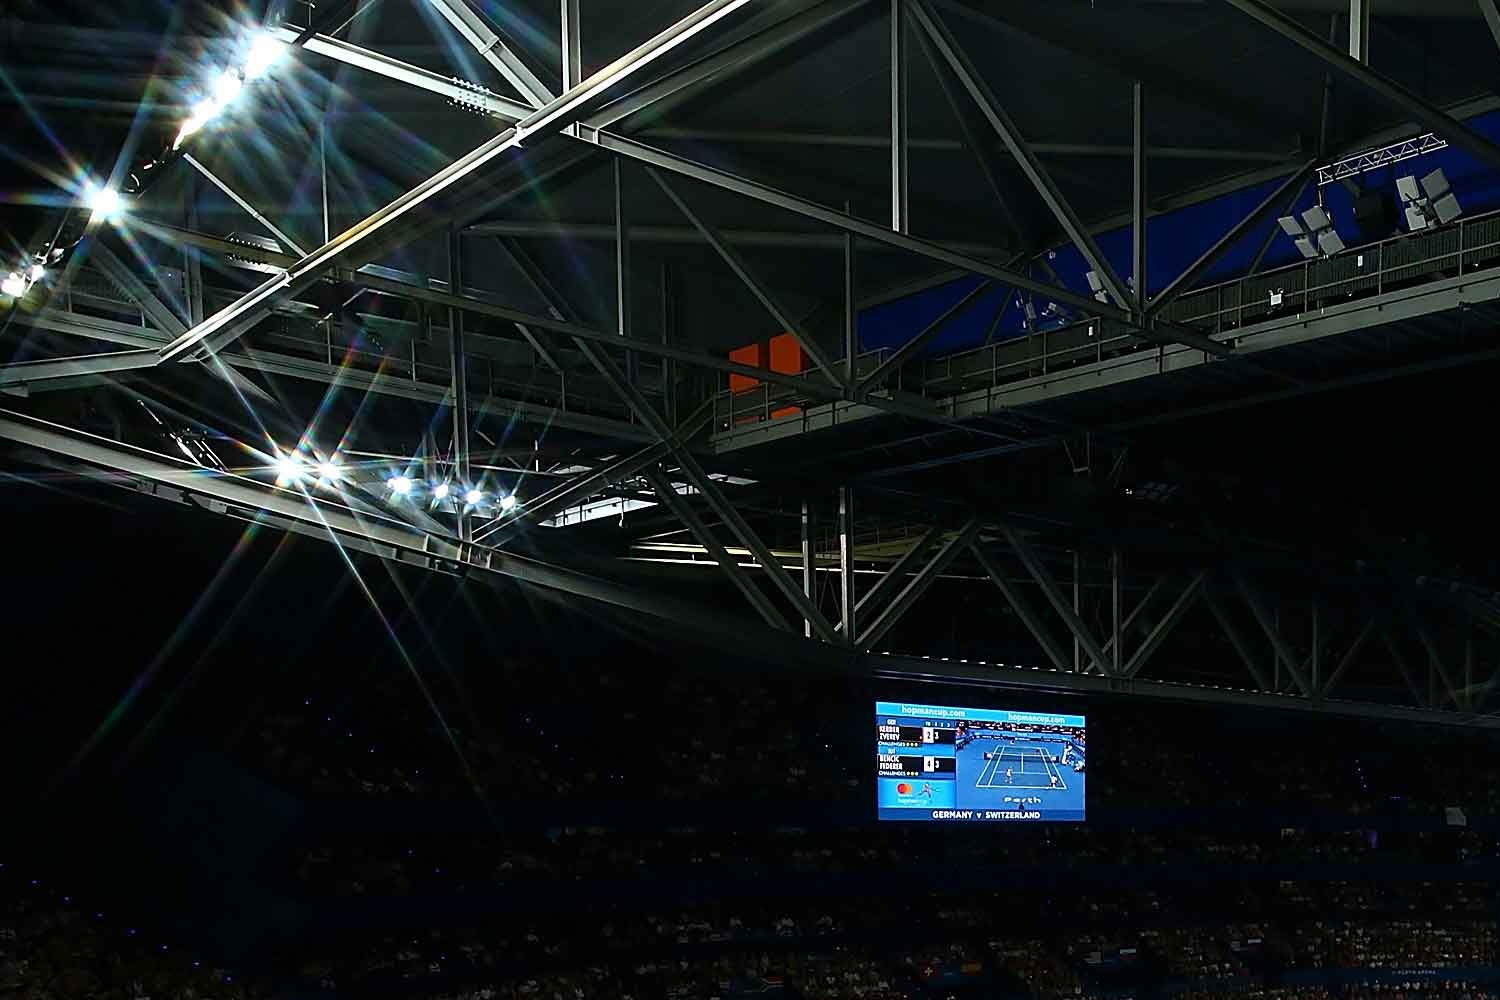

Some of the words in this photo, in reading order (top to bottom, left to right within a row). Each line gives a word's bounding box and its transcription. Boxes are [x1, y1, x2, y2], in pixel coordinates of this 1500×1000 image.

[902, 705, 966, 718] hopmancup.com
[1007, 711, 1065, 725] hopmancup.com
[932, 811, 973, 819] GERMANY
[985, 811, 1041, 819] SWITZERLAND
